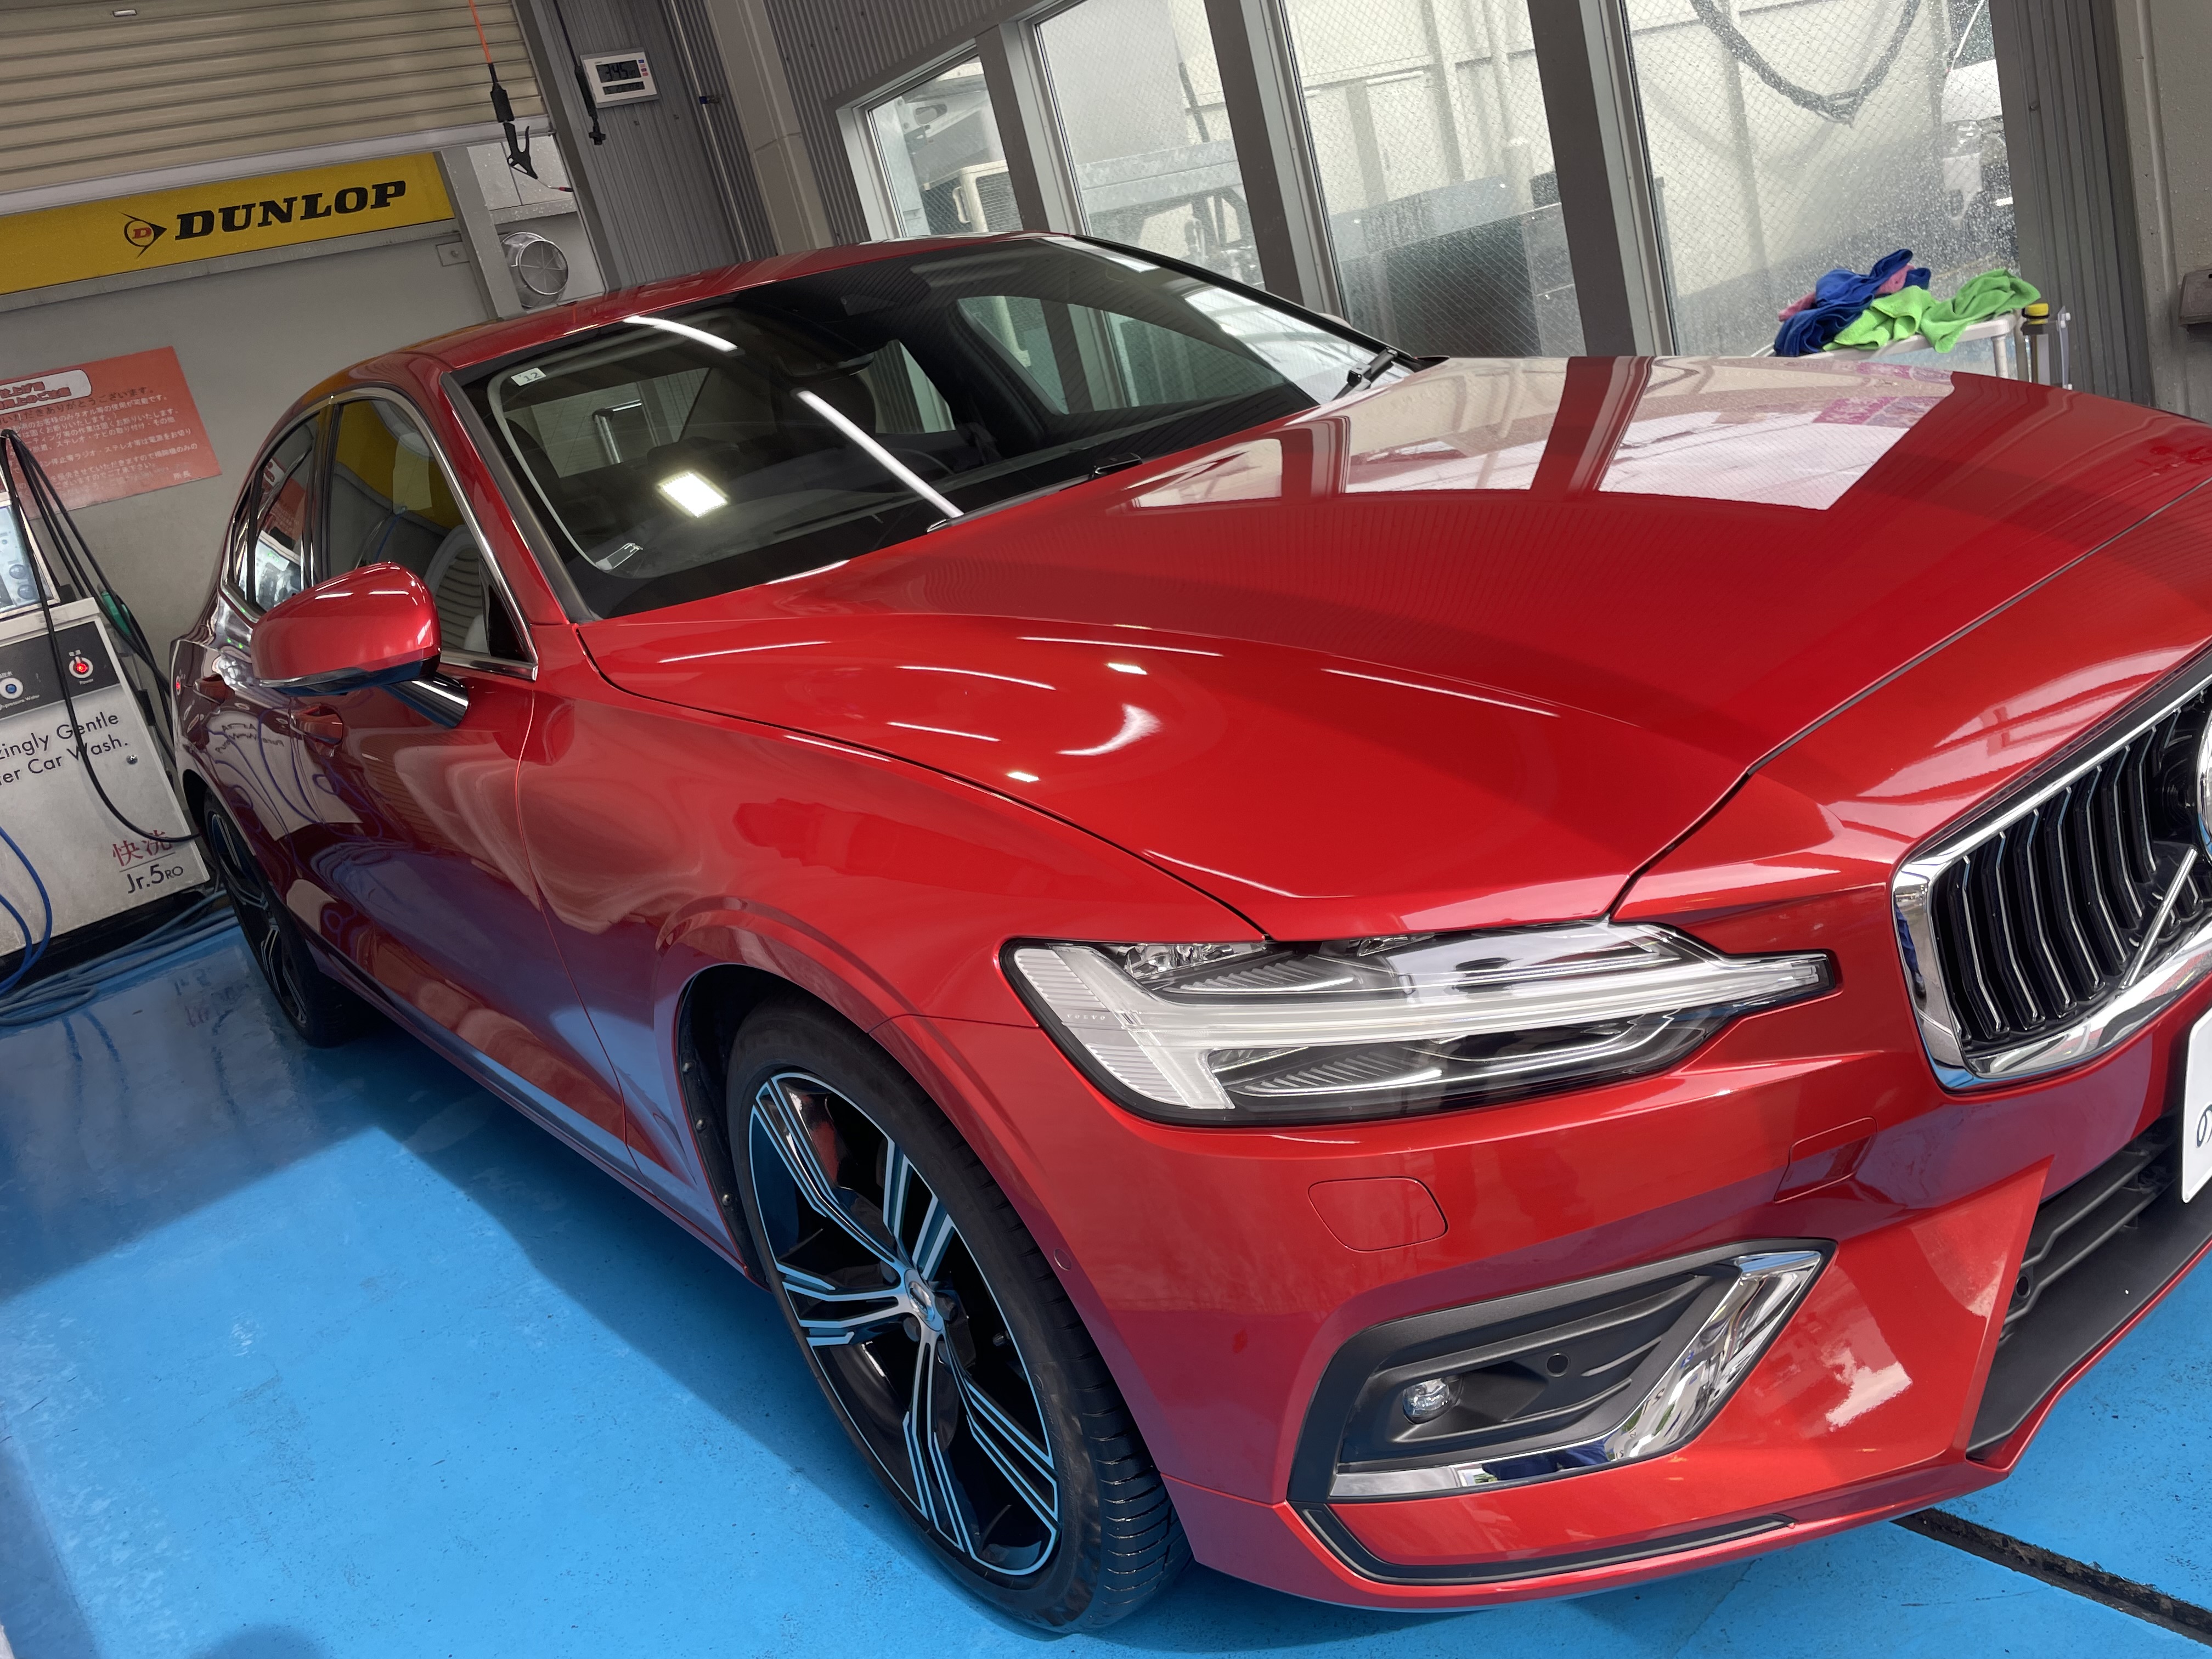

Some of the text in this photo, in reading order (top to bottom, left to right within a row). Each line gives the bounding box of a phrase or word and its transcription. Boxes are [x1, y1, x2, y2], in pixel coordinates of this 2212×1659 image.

[175, 180, 407, 240] DUNLOP
[523, 372, 541, 382] 12
[56, 712, 119, 740] Gentle
[0, 734, 128, 786] er Car Wash.
[112, 830, 173, 866] 快洗
